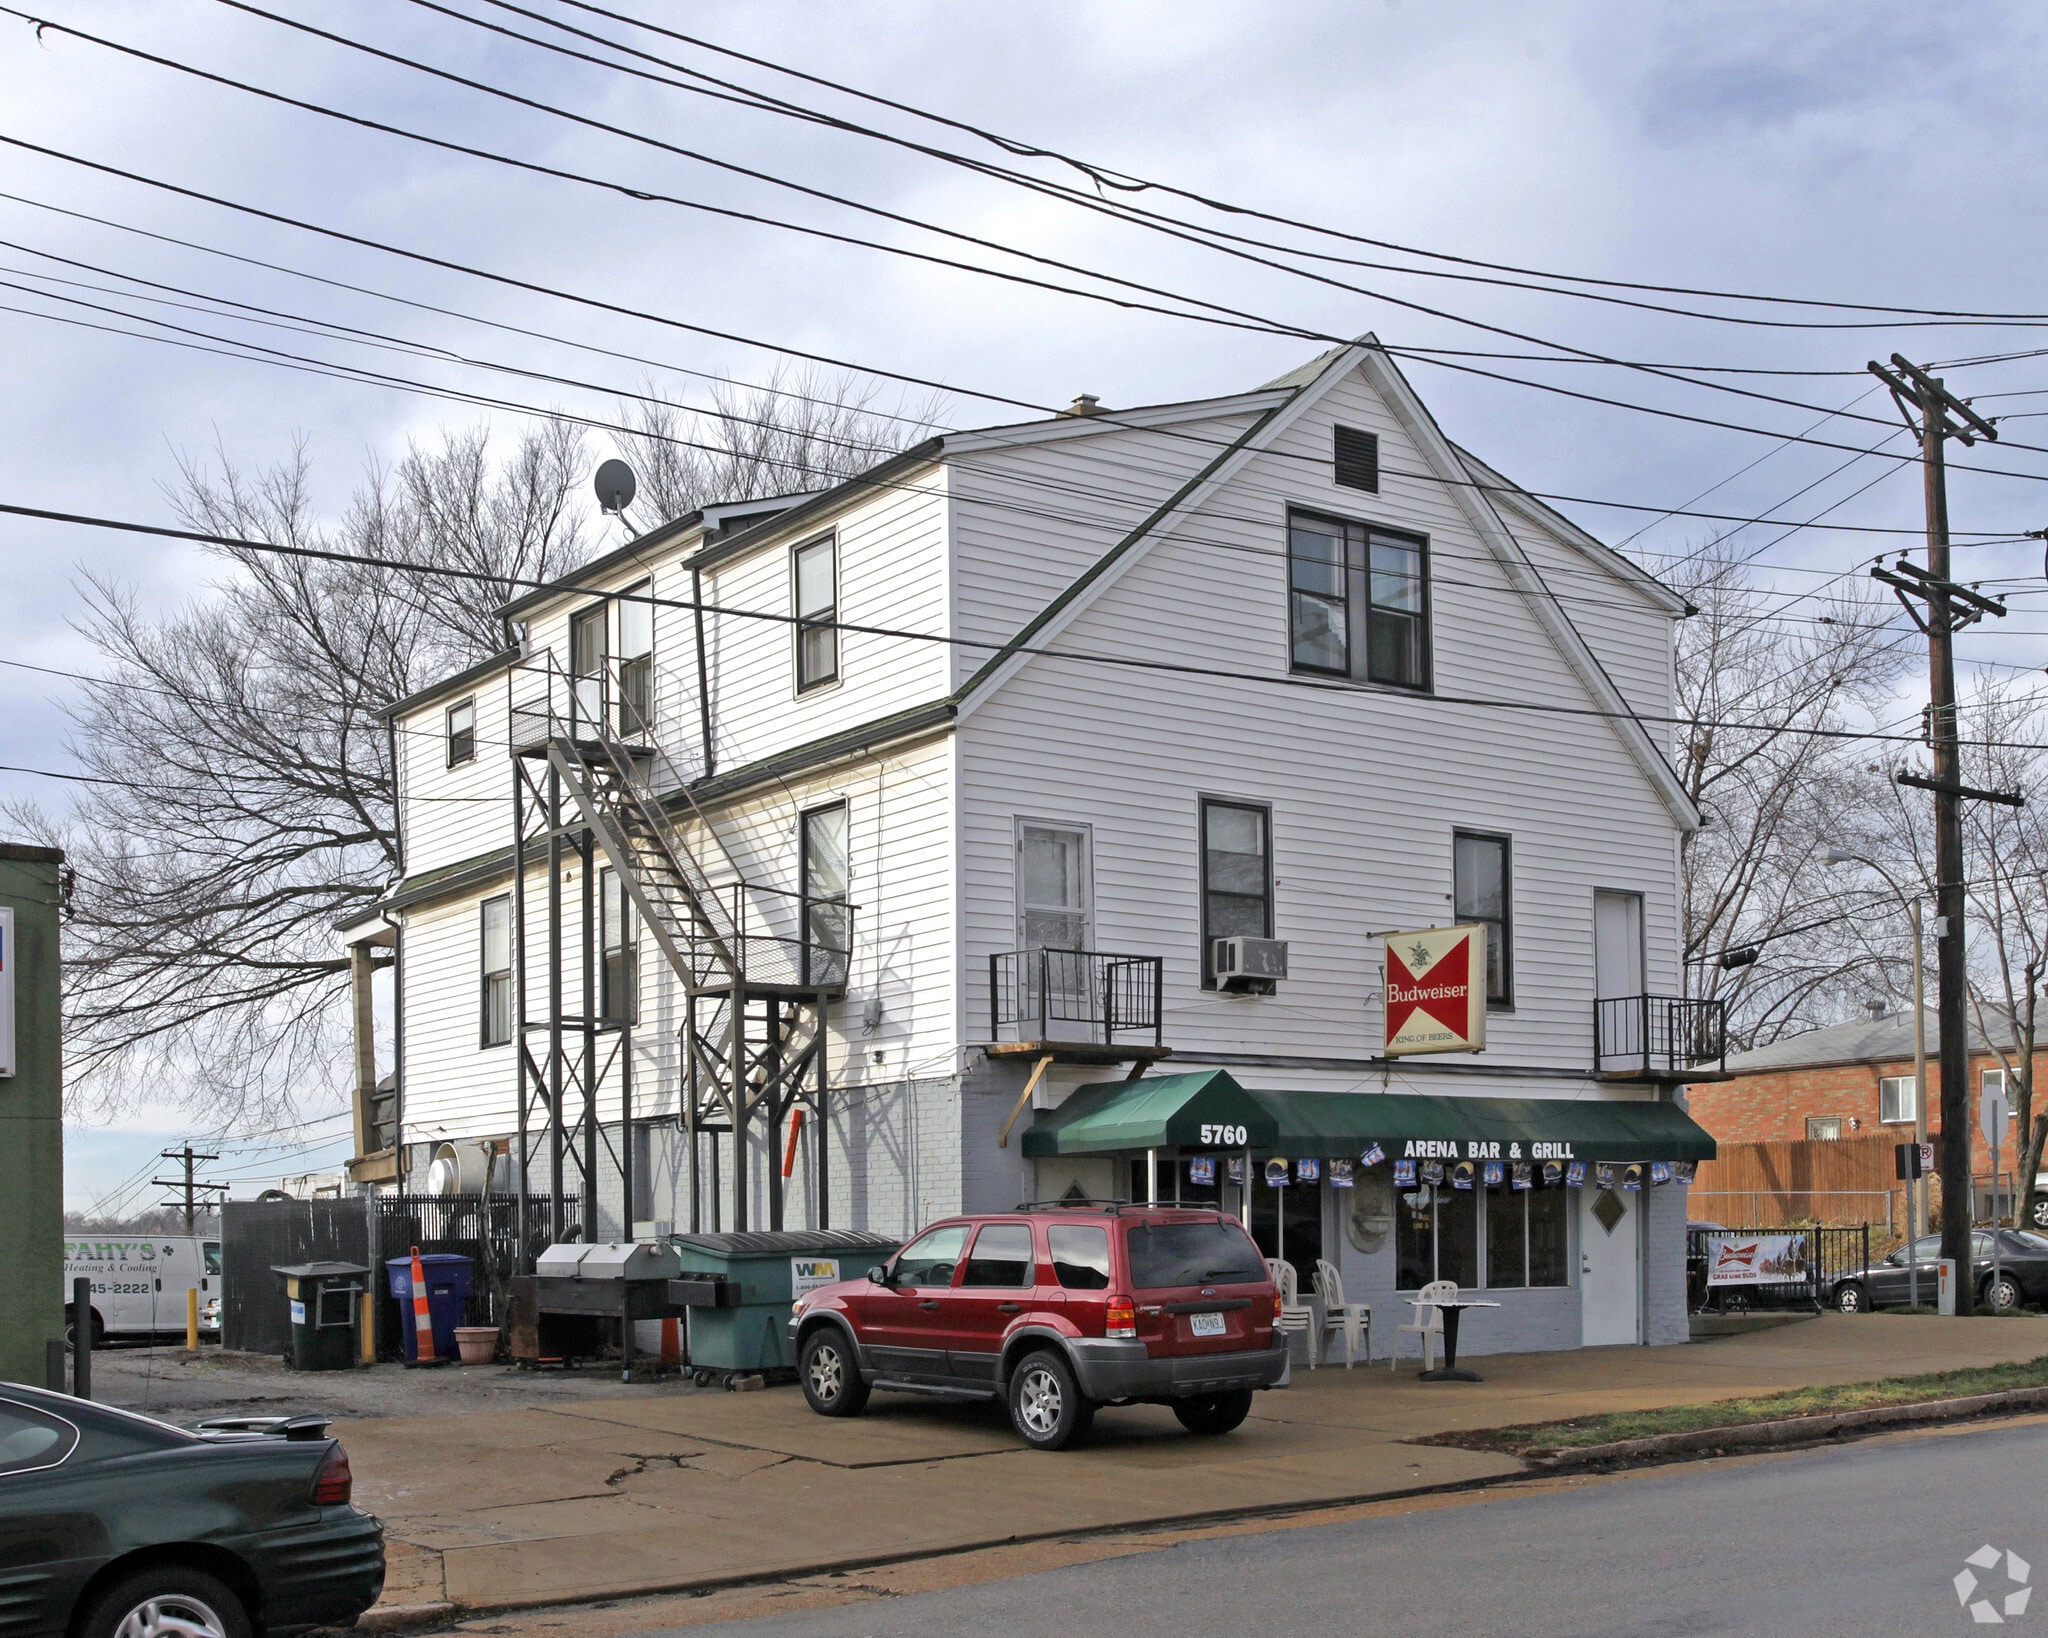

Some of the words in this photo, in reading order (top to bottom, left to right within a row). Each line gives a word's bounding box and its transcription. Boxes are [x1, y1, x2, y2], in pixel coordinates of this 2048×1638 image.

[1387, 983, 1467, 1003] Budweiser
[1395, 1035, 1415, 1044] KING
[1416, 1034, 1427, 1043] OF
[1428, 1032, 1453, 1041] BEERS
[1200, 1124, 1248, 1146] 5760
[1404, 1140, 1459, 1158] ARENA
[1468, 1141, 1501, 1159] BAR
[1509, 1142, 1522, 1159] &
[1531, 1142, 1575, 1159] GRILL
[64, 1263, 104, 1274] Heating
[107, 1263, 115, 1272] &
[119, 1263, 157, 1274] Cooling
[795, 1262, 835, 1277] WM
[90, 1283, 149, 1294] 45-2222
